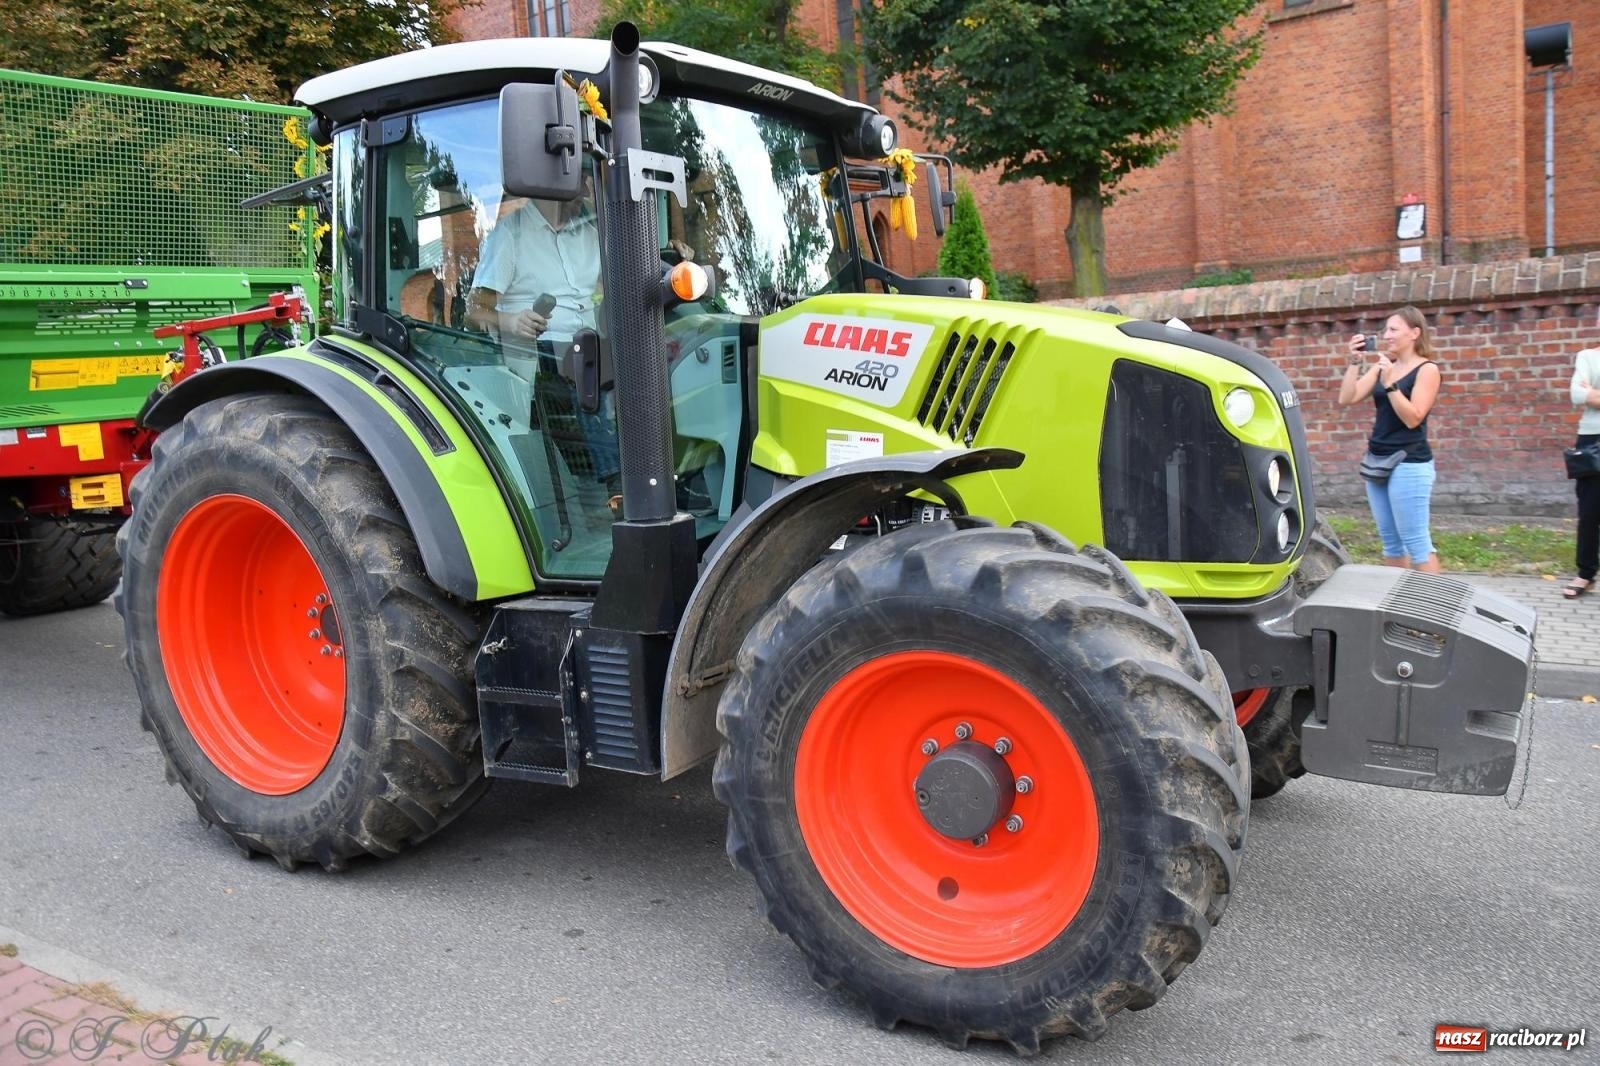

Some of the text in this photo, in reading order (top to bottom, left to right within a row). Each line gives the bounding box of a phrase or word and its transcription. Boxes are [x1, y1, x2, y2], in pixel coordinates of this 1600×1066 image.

[747, 82, 794, 101] ARION
[803, 322, 913, 357] CLAAS
[824, 368, 889, 392] ARION
[855, 359, 900, 379] 420
